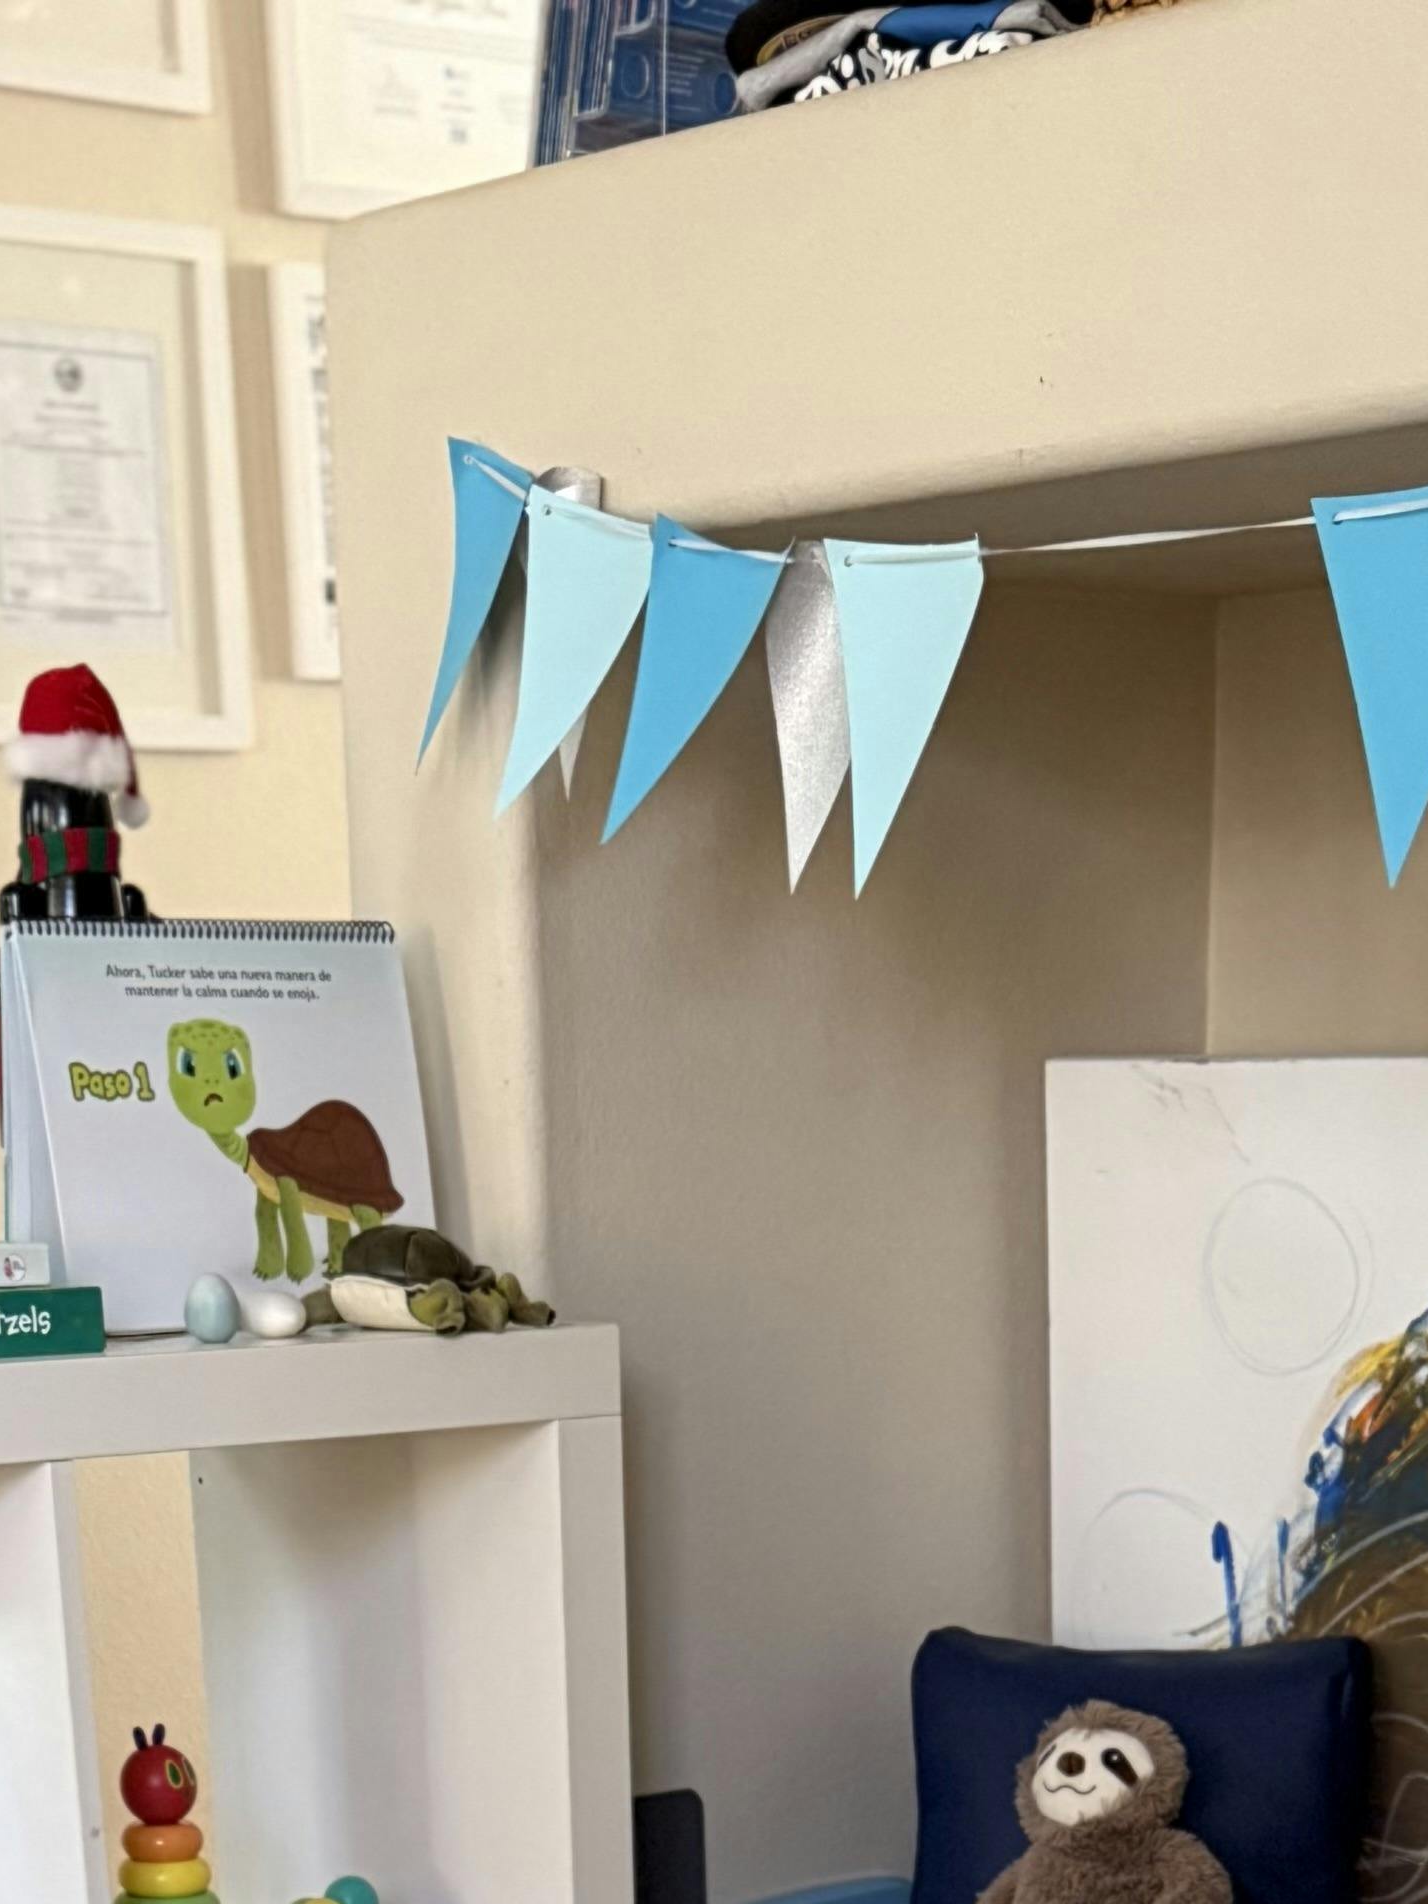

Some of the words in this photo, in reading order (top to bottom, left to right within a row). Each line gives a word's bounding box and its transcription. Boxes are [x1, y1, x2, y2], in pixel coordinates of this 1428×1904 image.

[106, 964, 146, 979] Ahora,
[147, 965, 186, 979] Tucker
[190, 966, 214, 980] sabe
[218, 971, 238, 981] una
[241, 971, 273, 981] nueva
[275, 971, 316, 982] manera
[318, 969, 332, 982] de
[125, 985, 179, 998] mantener
[182, 985, 192, 997] la
[195, 985, 227, 998] calma
[230, 985, 269, 999] cuando
[273, 989, 283, 999] se
[287, 988, 320, 1003] enoja.
[68, 1061, 132, 1101] Paso
[135, 1061, 156, 1102] 1
